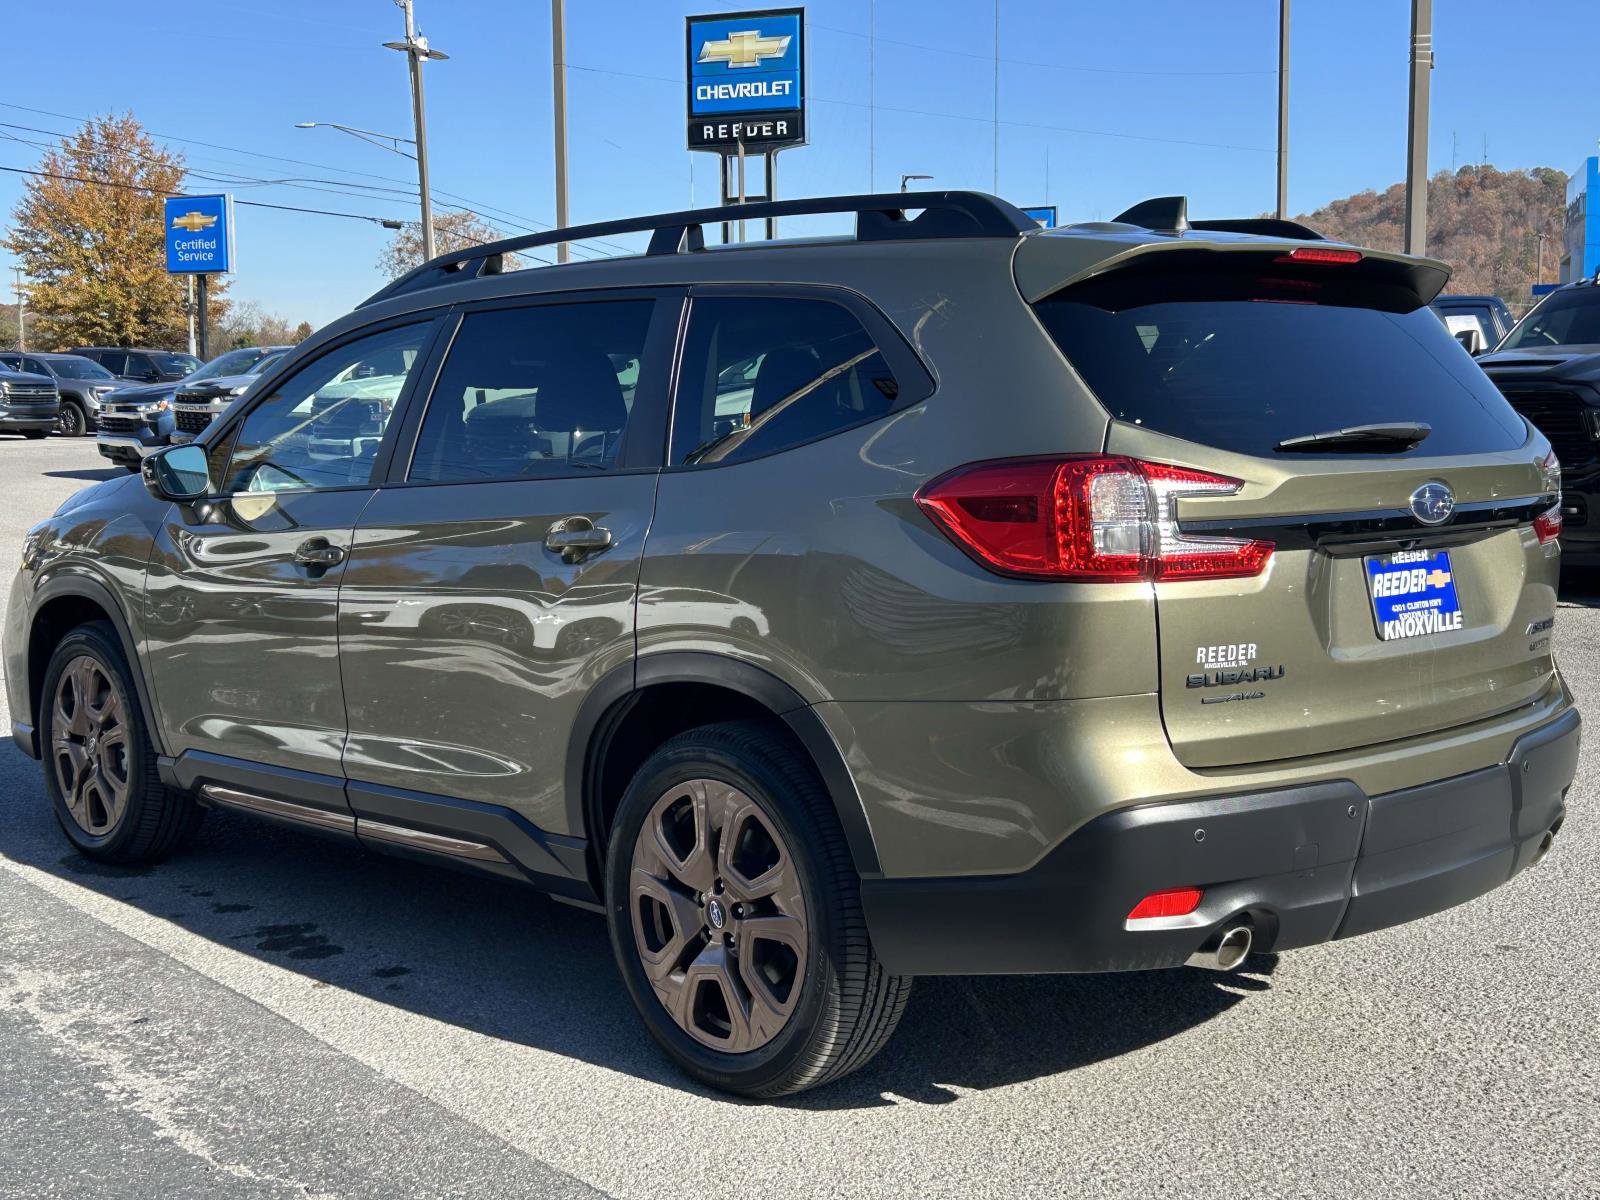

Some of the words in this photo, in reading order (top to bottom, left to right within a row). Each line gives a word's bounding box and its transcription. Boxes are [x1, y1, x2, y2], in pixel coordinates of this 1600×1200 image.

[696, 80, 792, 100] CHEVROLET
[703, 121, 788, 140] REEDER
[174, 238, 216, 250] Certified
[178, 250, 214, 262] Service
[1391, 549, 1428, 564] REEDER
[1373, 568, 1426, 598] REEDER
[1384, 610, 1462, 640] KNOXVILLE
[1196, 643, 1257, 663] REEDER
[1186, 664, 1285, 689] SUBARU
